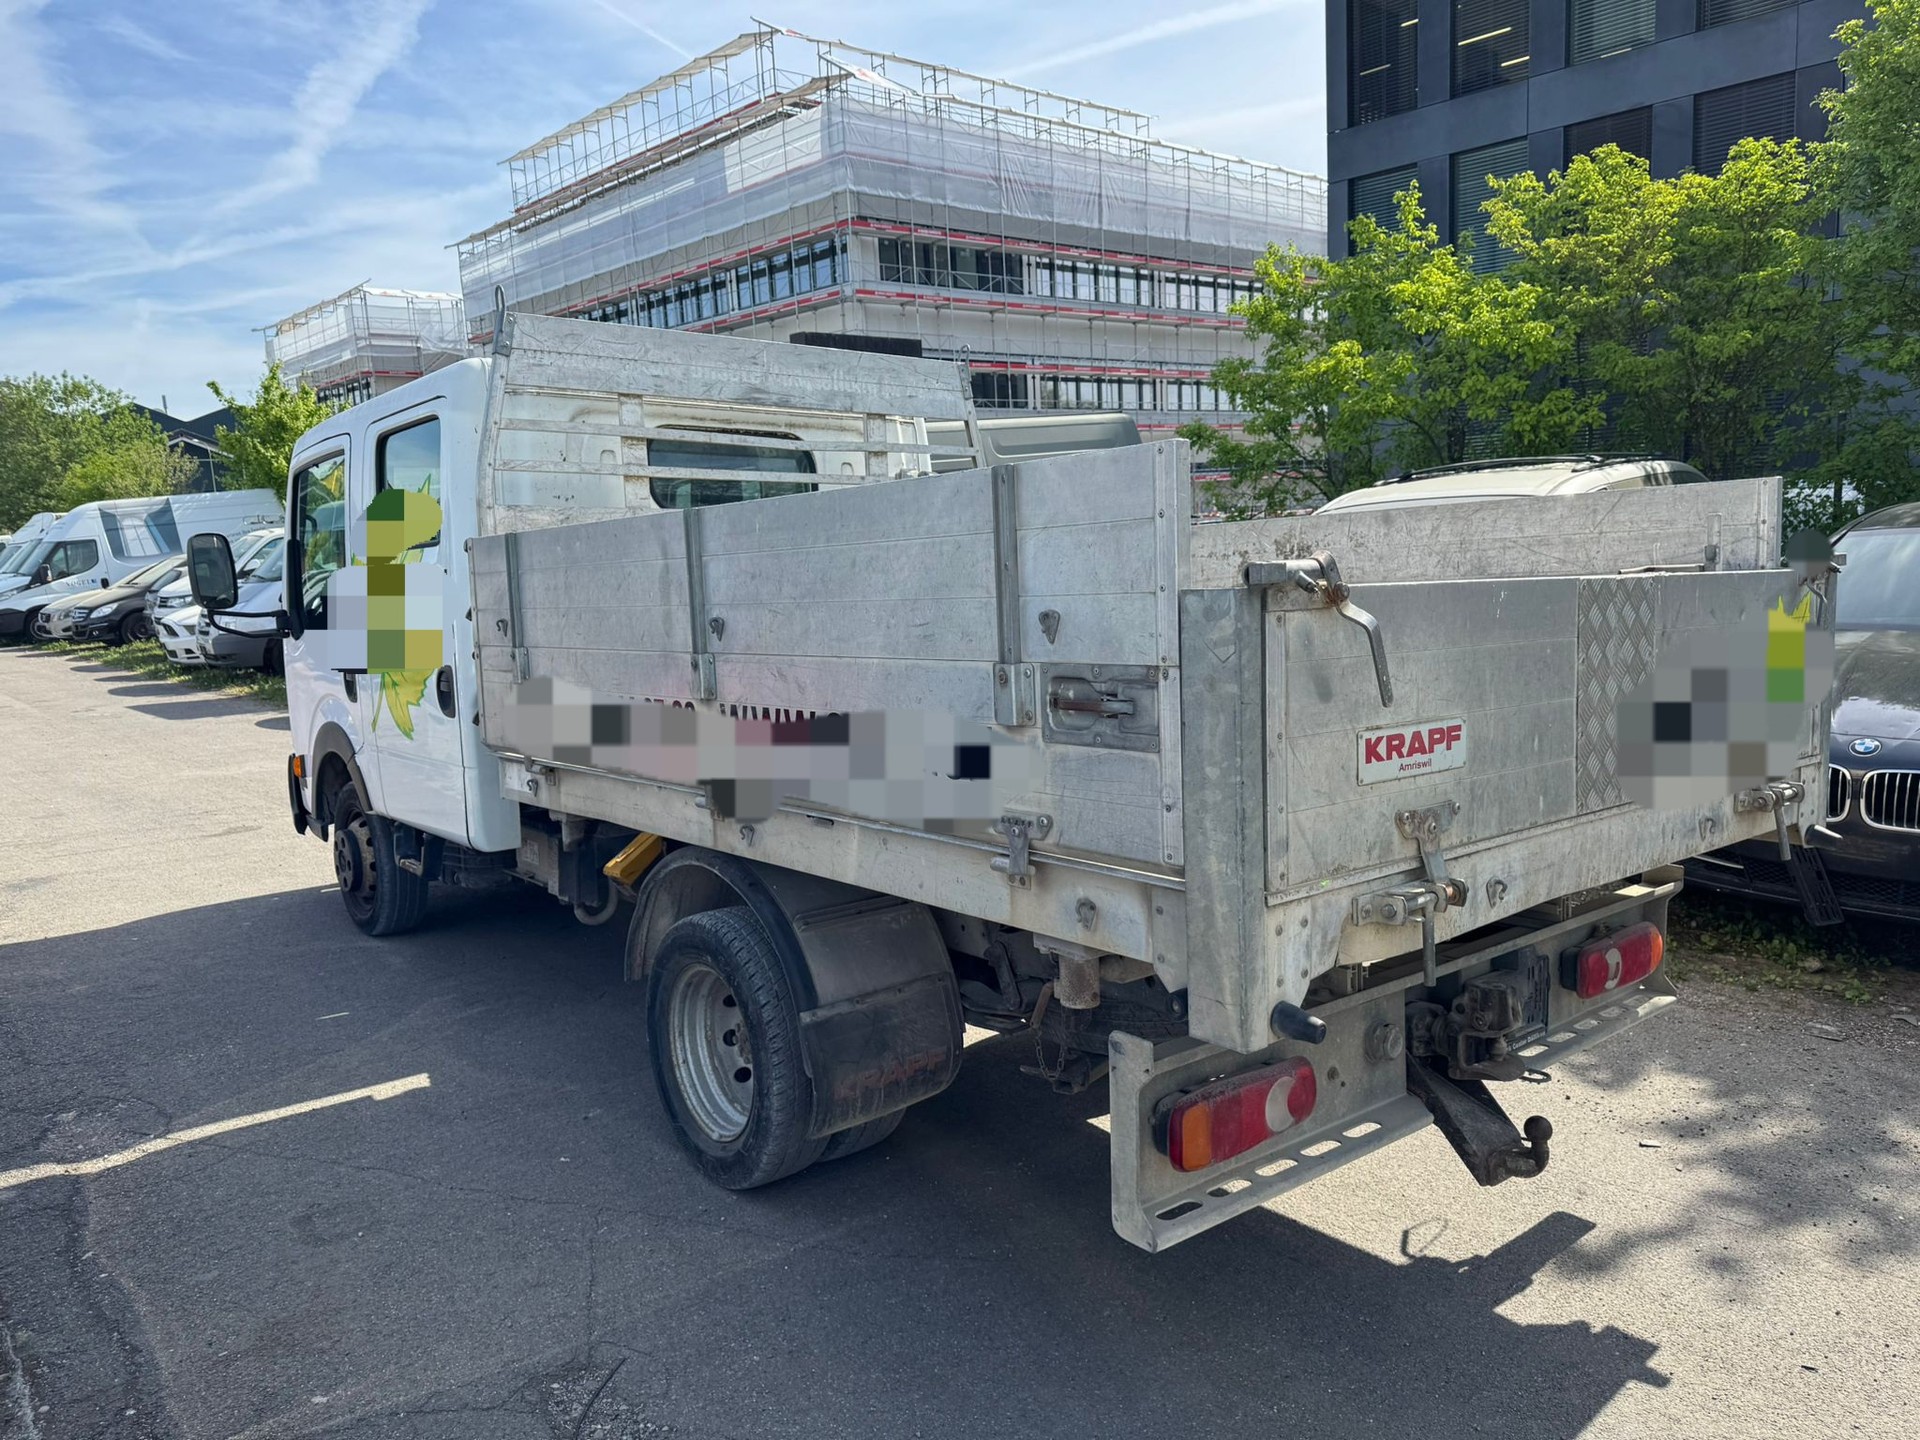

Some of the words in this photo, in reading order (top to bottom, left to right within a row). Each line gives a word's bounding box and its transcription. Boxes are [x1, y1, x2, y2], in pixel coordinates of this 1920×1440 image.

[1364, 724, 1462, 765] KRAPF
[1398, 758, 1432, 772] Amriswil
[833, 1047, 946, 1100] KRAPF
